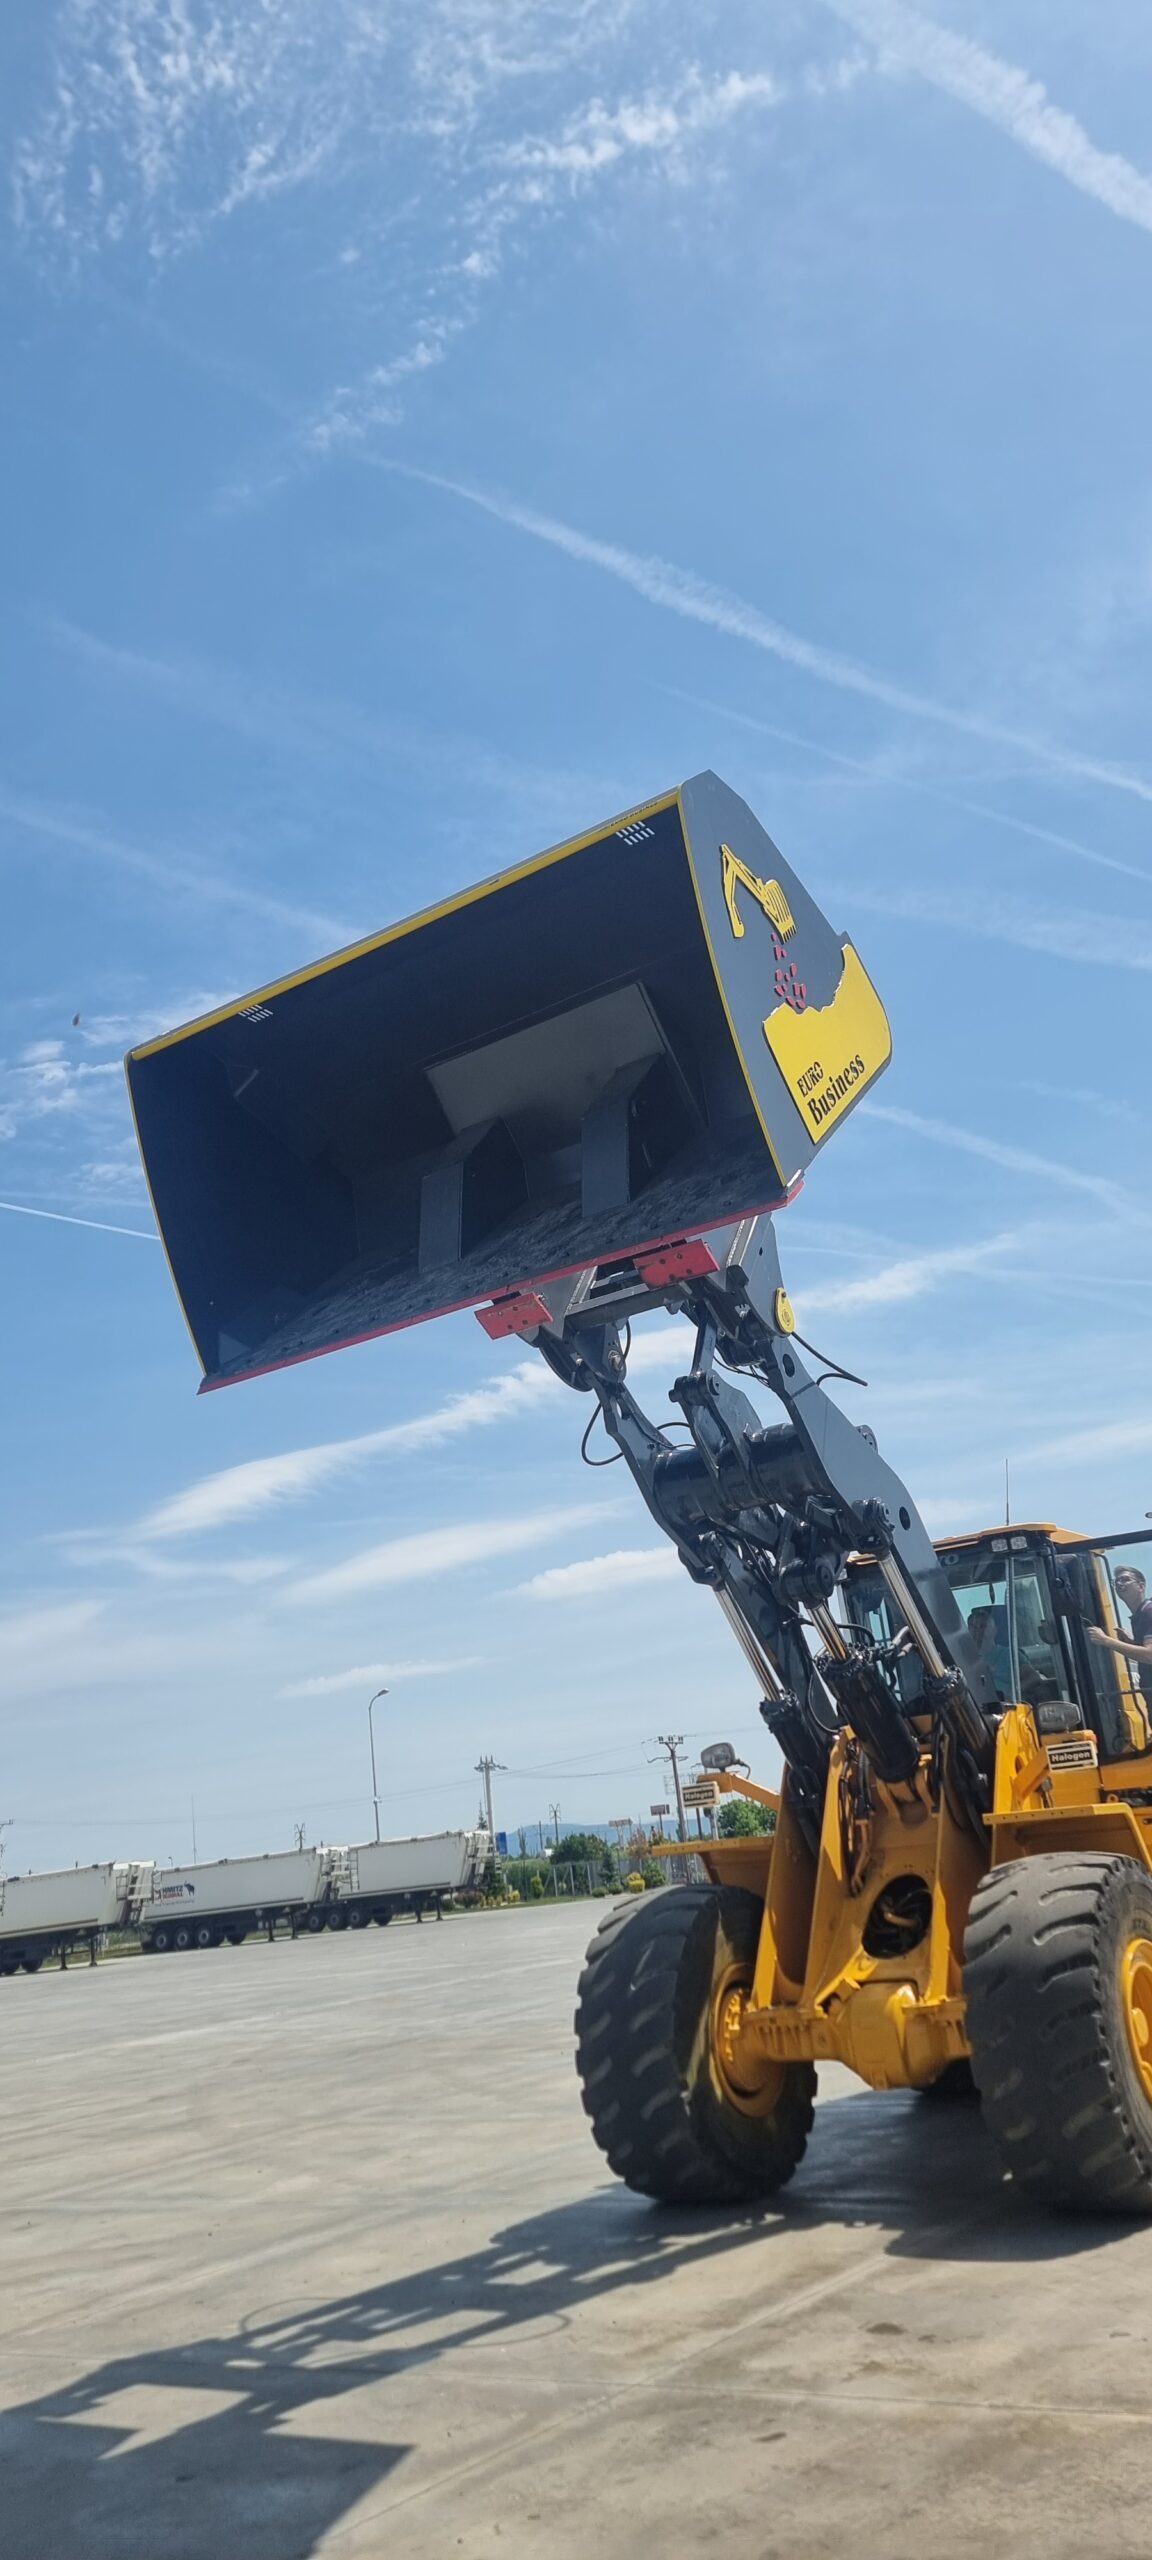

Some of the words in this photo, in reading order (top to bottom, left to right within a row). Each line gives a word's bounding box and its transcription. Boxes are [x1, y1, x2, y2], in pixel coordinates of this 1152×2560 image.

[797, 1061, 824, 1097] EURO
[807, 1054, 865, 1125] Business
[1051, 1751, 1091, 1762] Halogen
[684, 1790, 713, 1800] Halogen
